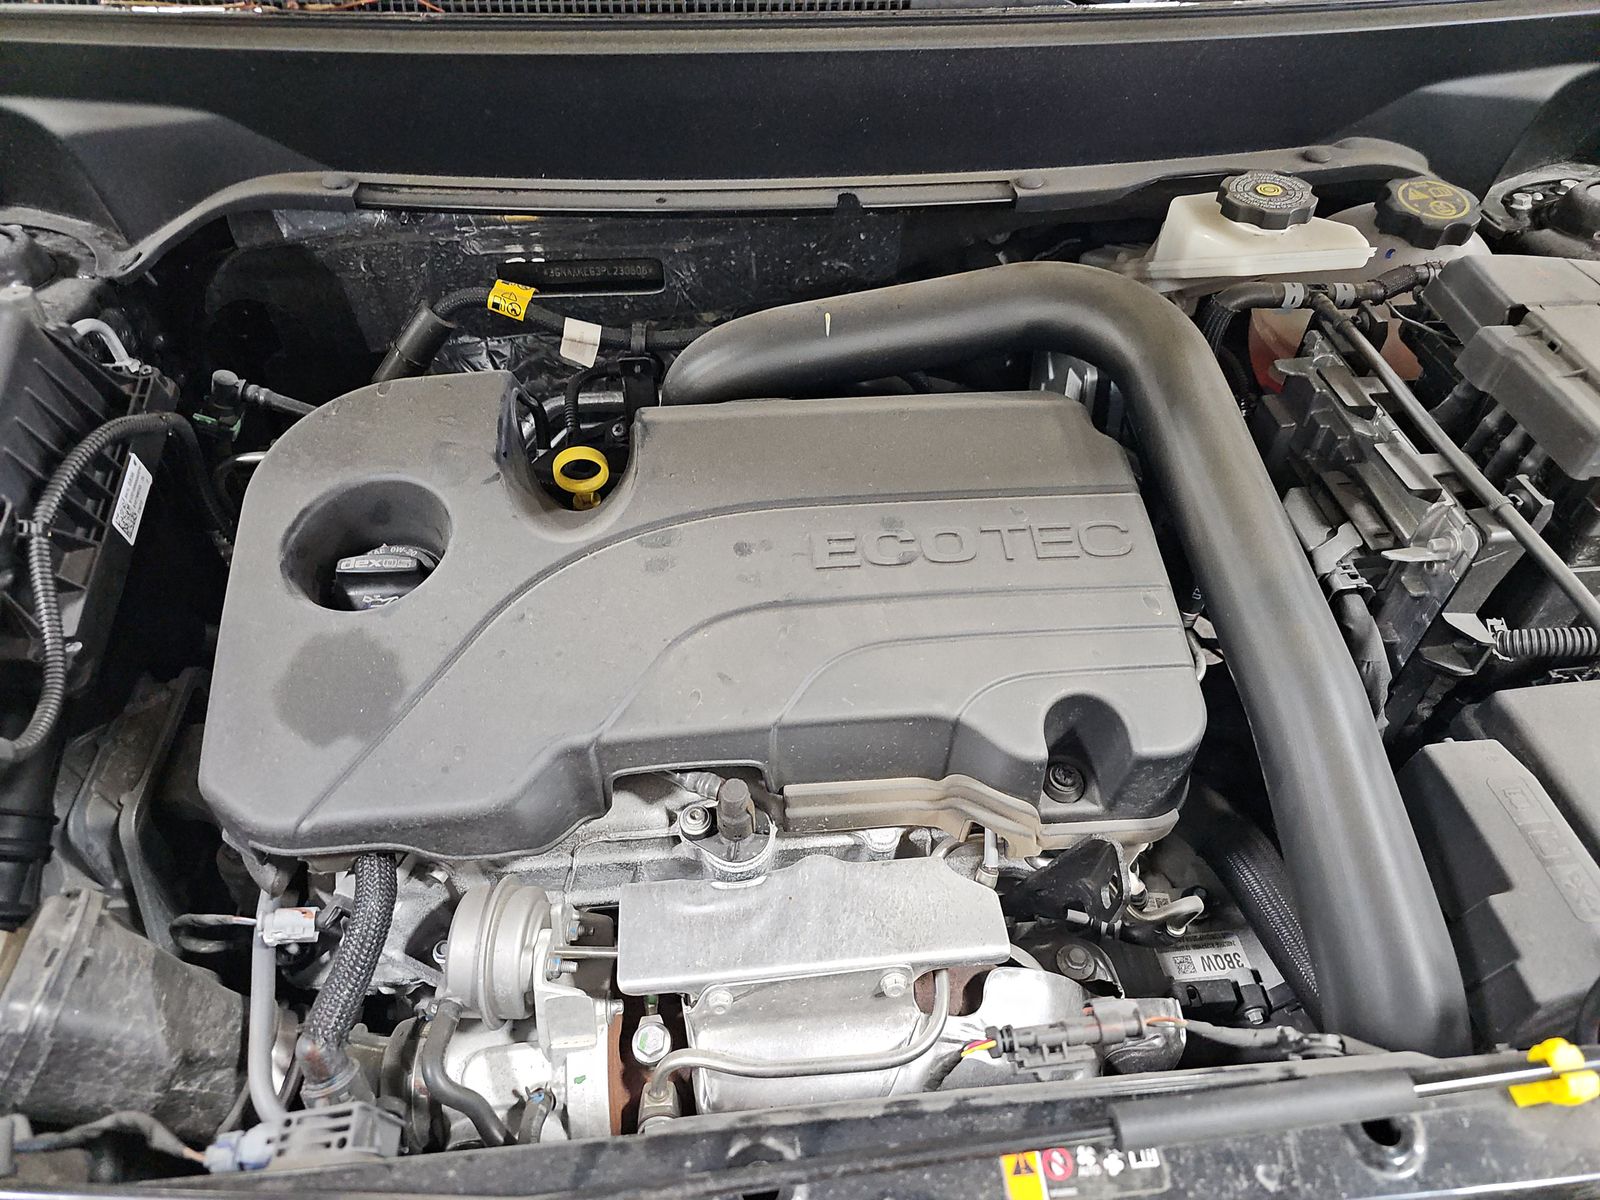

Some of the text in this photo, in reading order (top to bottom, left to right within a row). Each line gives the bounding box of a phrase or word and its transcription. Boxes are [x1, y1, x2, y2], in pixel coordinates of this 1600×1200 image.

[390, 546, 418, 557] 0W-20
[810, 521, 1134, 569] ECOTEC
[340, 558, 413, 570] dexos
[1200, 952, 1245, 972] 3BQW
